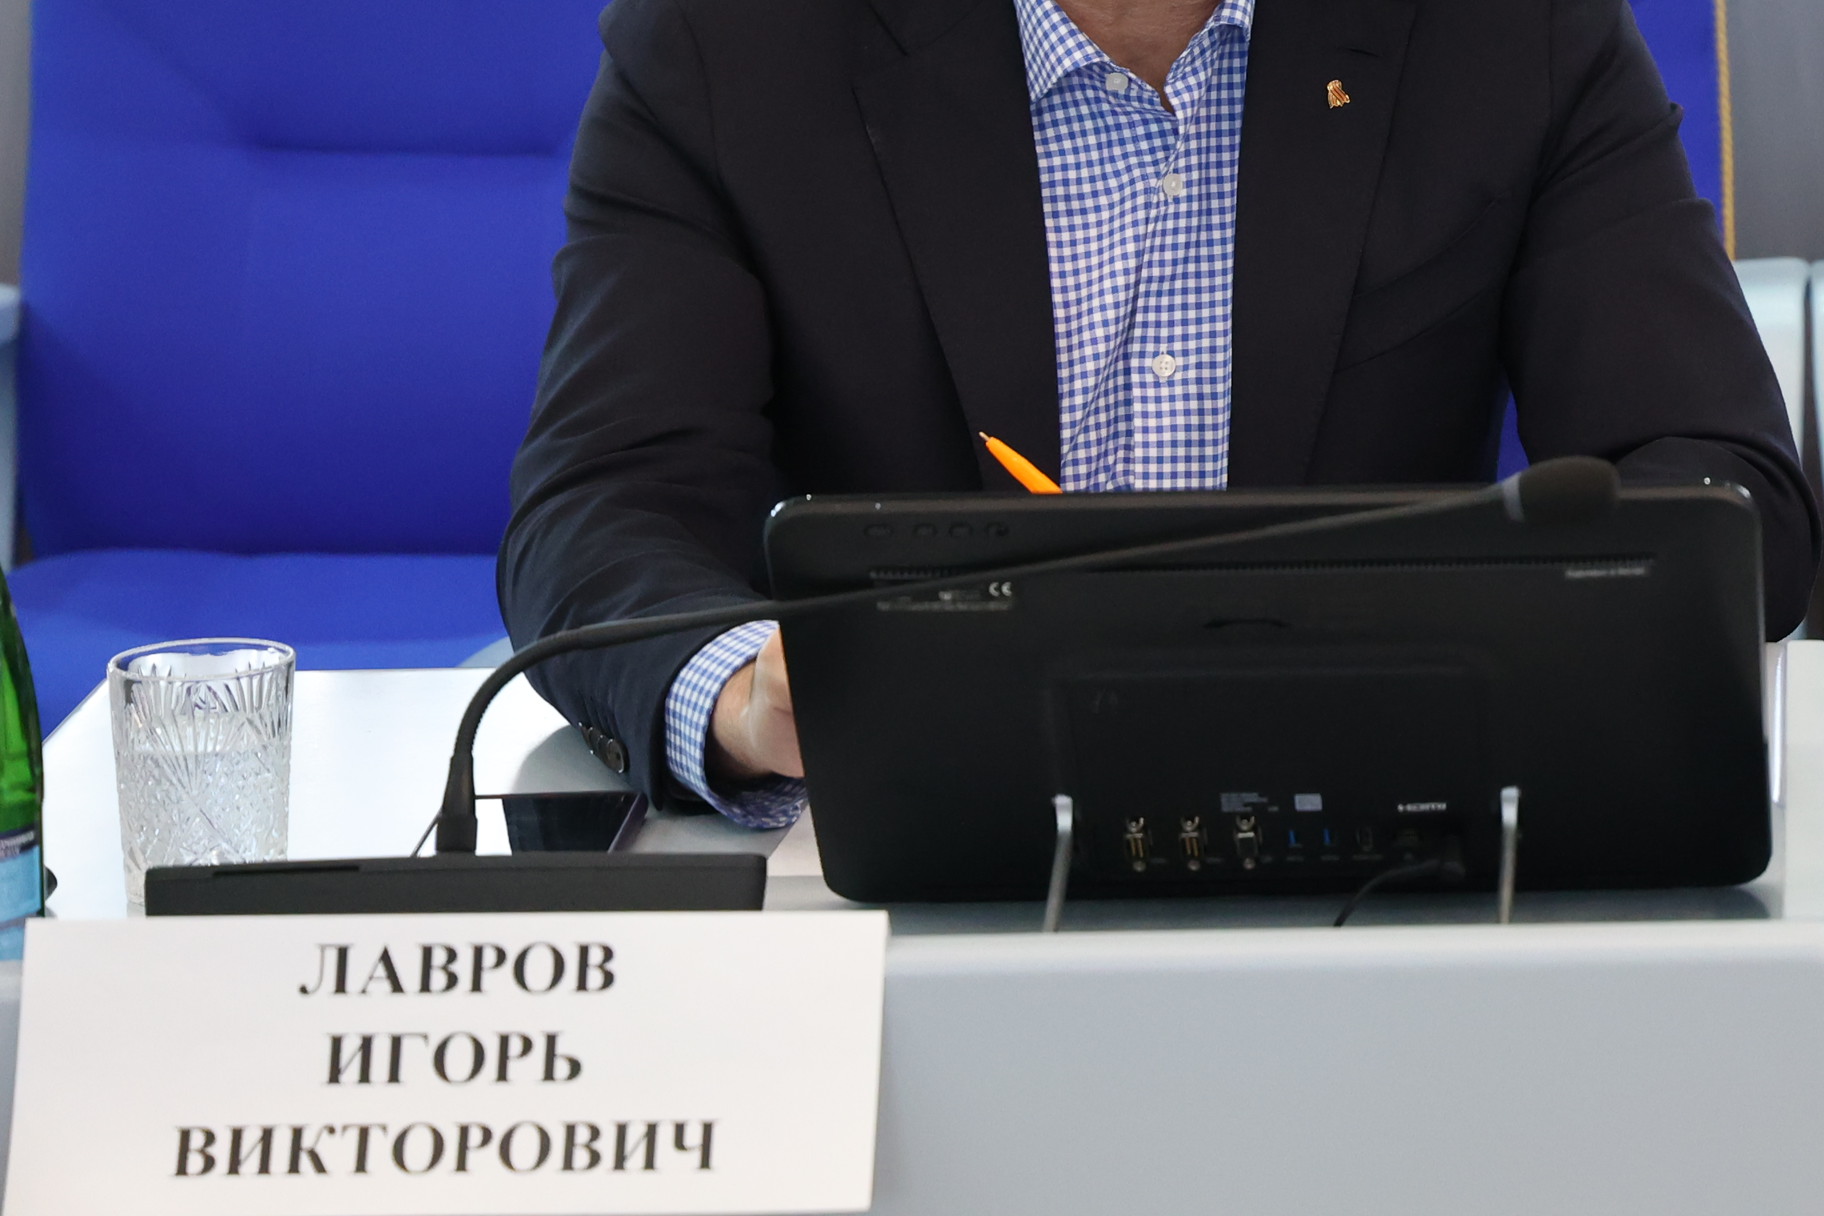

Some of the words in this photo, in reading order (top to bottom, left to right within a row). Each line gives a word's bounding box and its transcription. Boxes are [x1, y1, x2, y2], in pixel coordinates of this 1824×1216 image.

[298, 942, 617, 996] ЛАВРОВ
[325, 1031, 583, 1086] ИГОРЬ
[173, 1119, 719, 1177] ВИКТОРОВИЧ
